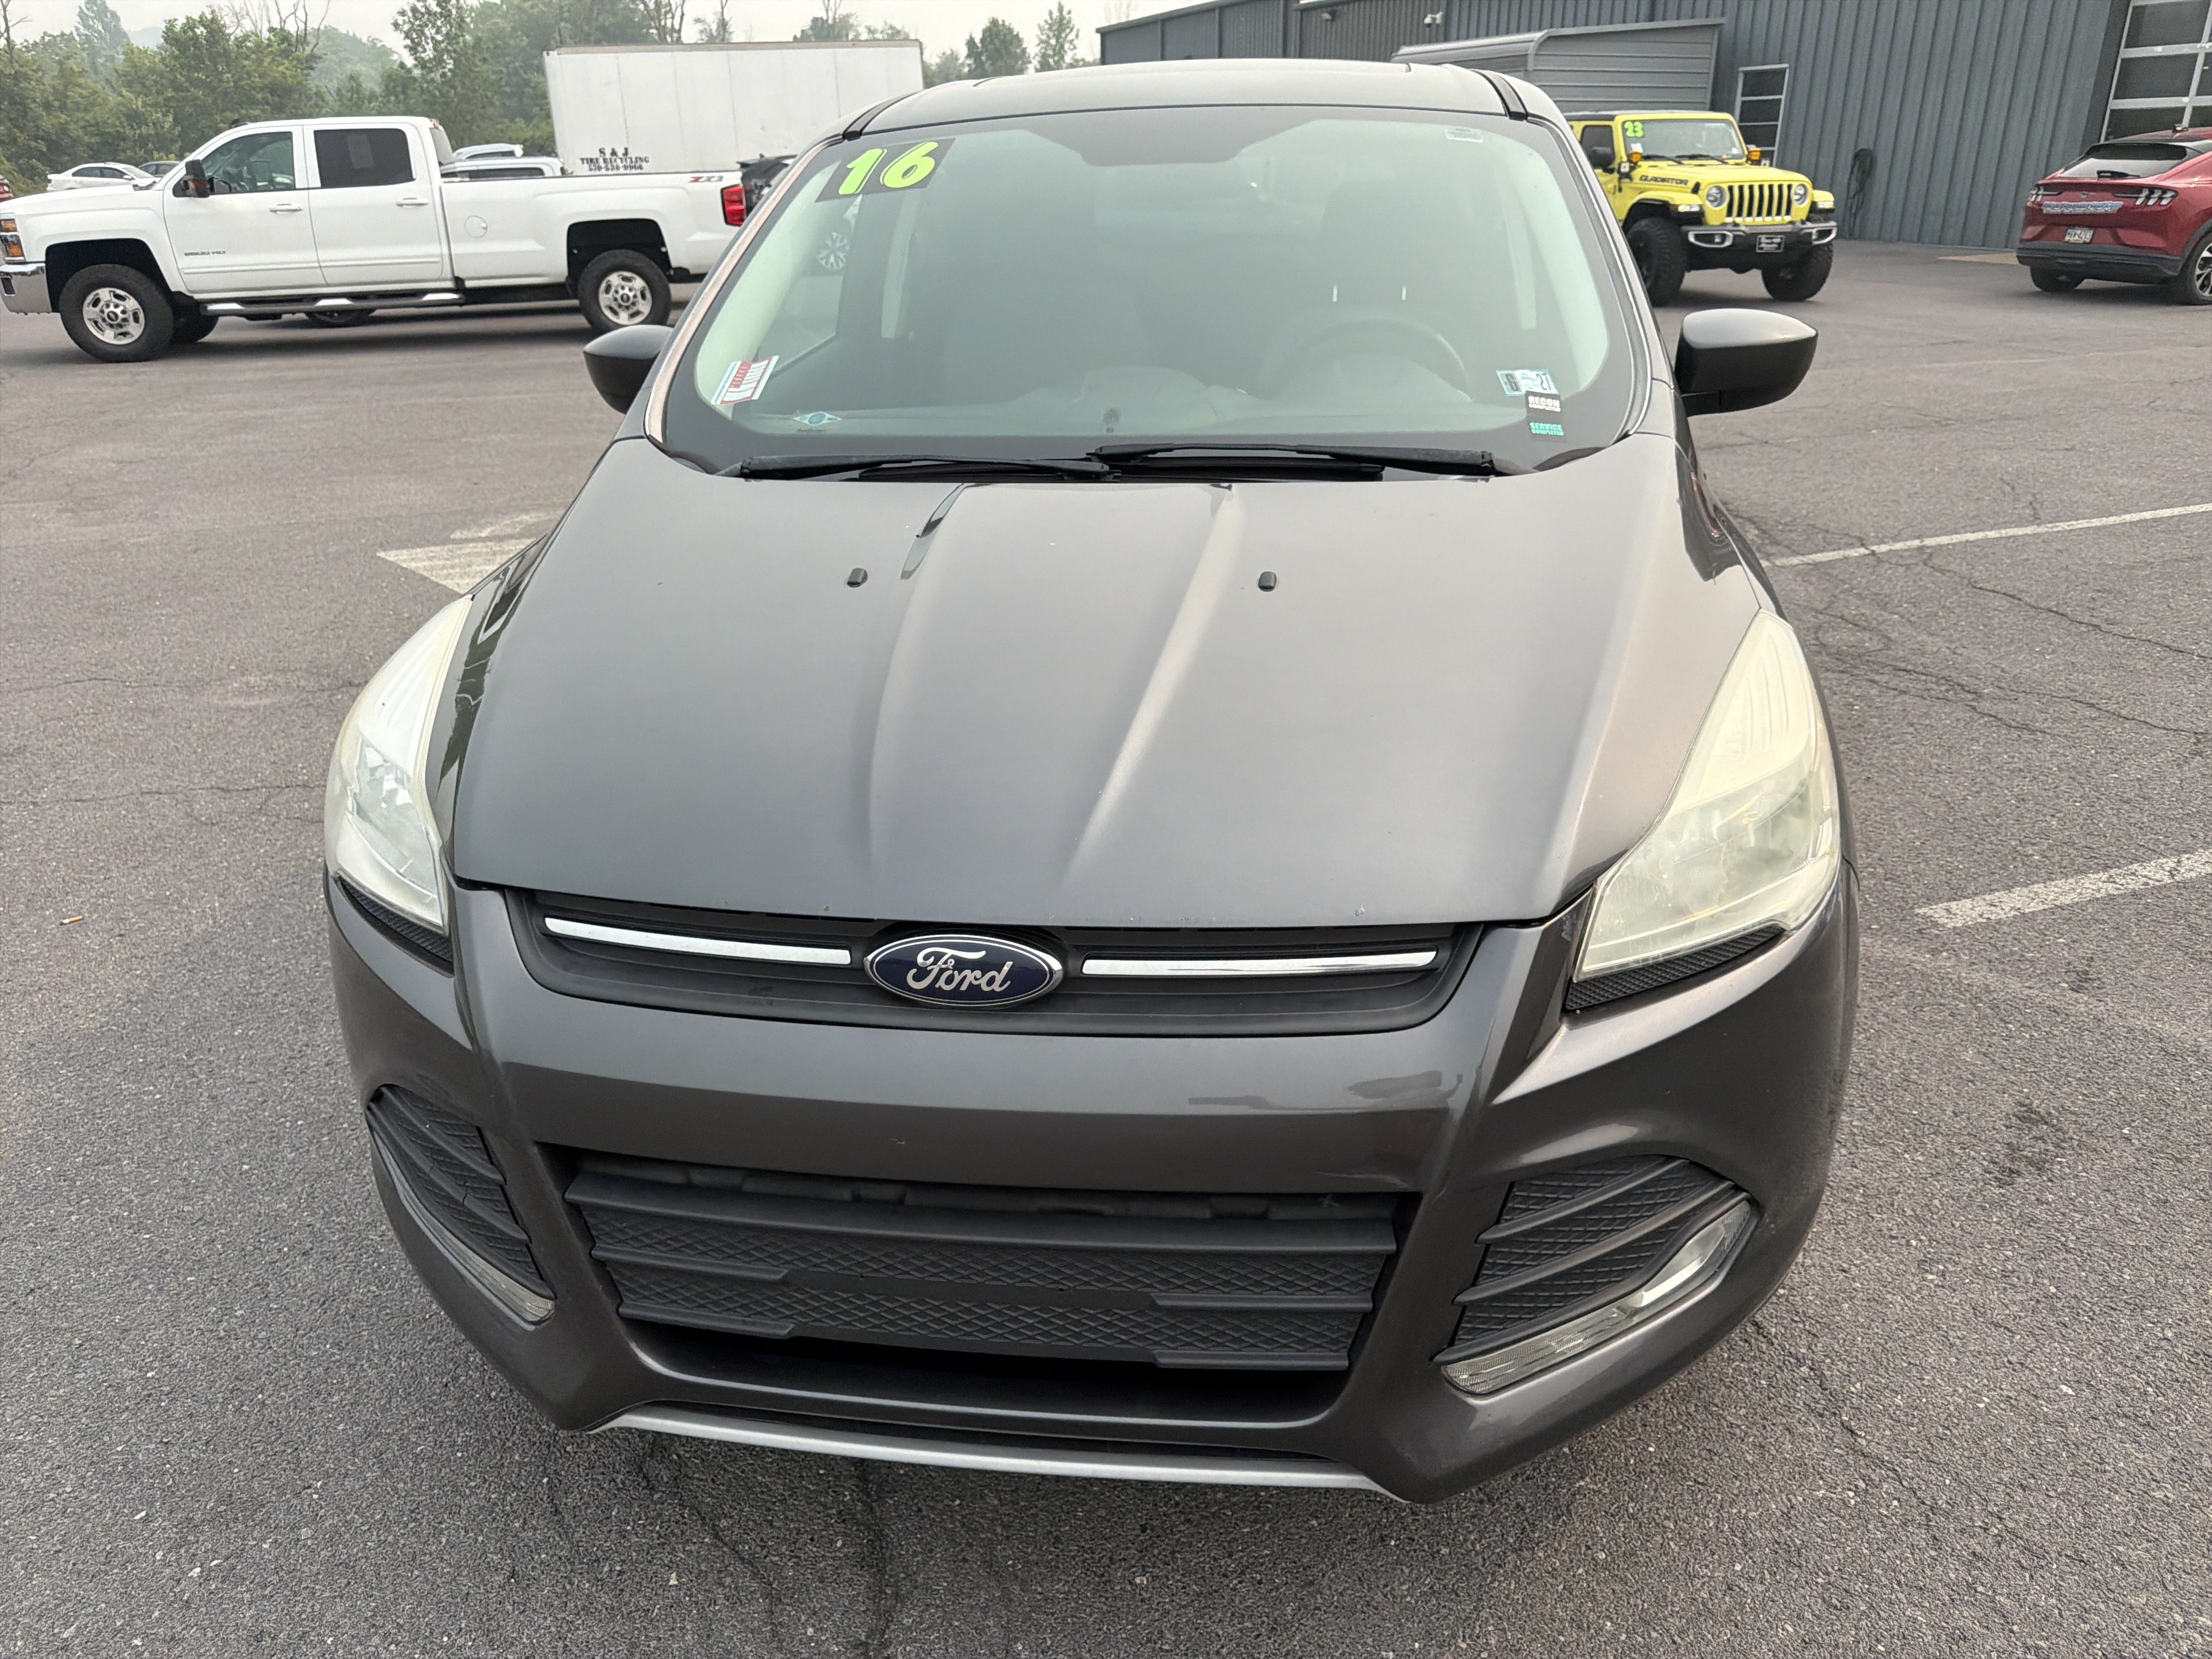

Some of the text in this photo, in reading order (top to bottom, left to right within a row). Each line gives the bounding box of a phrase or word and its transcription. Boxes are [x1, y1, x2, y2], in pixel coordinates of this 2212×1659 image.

[1624, 121, 1644, 137] 23
[599, 147, 606, 157] S
[623, 147, 629, 156] J
[838, 141, 939, 195] 16
[1639, 174, 1689, 185] GLADIATOR
[1528, 396, 1560, 408] RECON
[1530, 422, 1562, 431] SERVICE
[906, 947, 1013, 992] Ford
